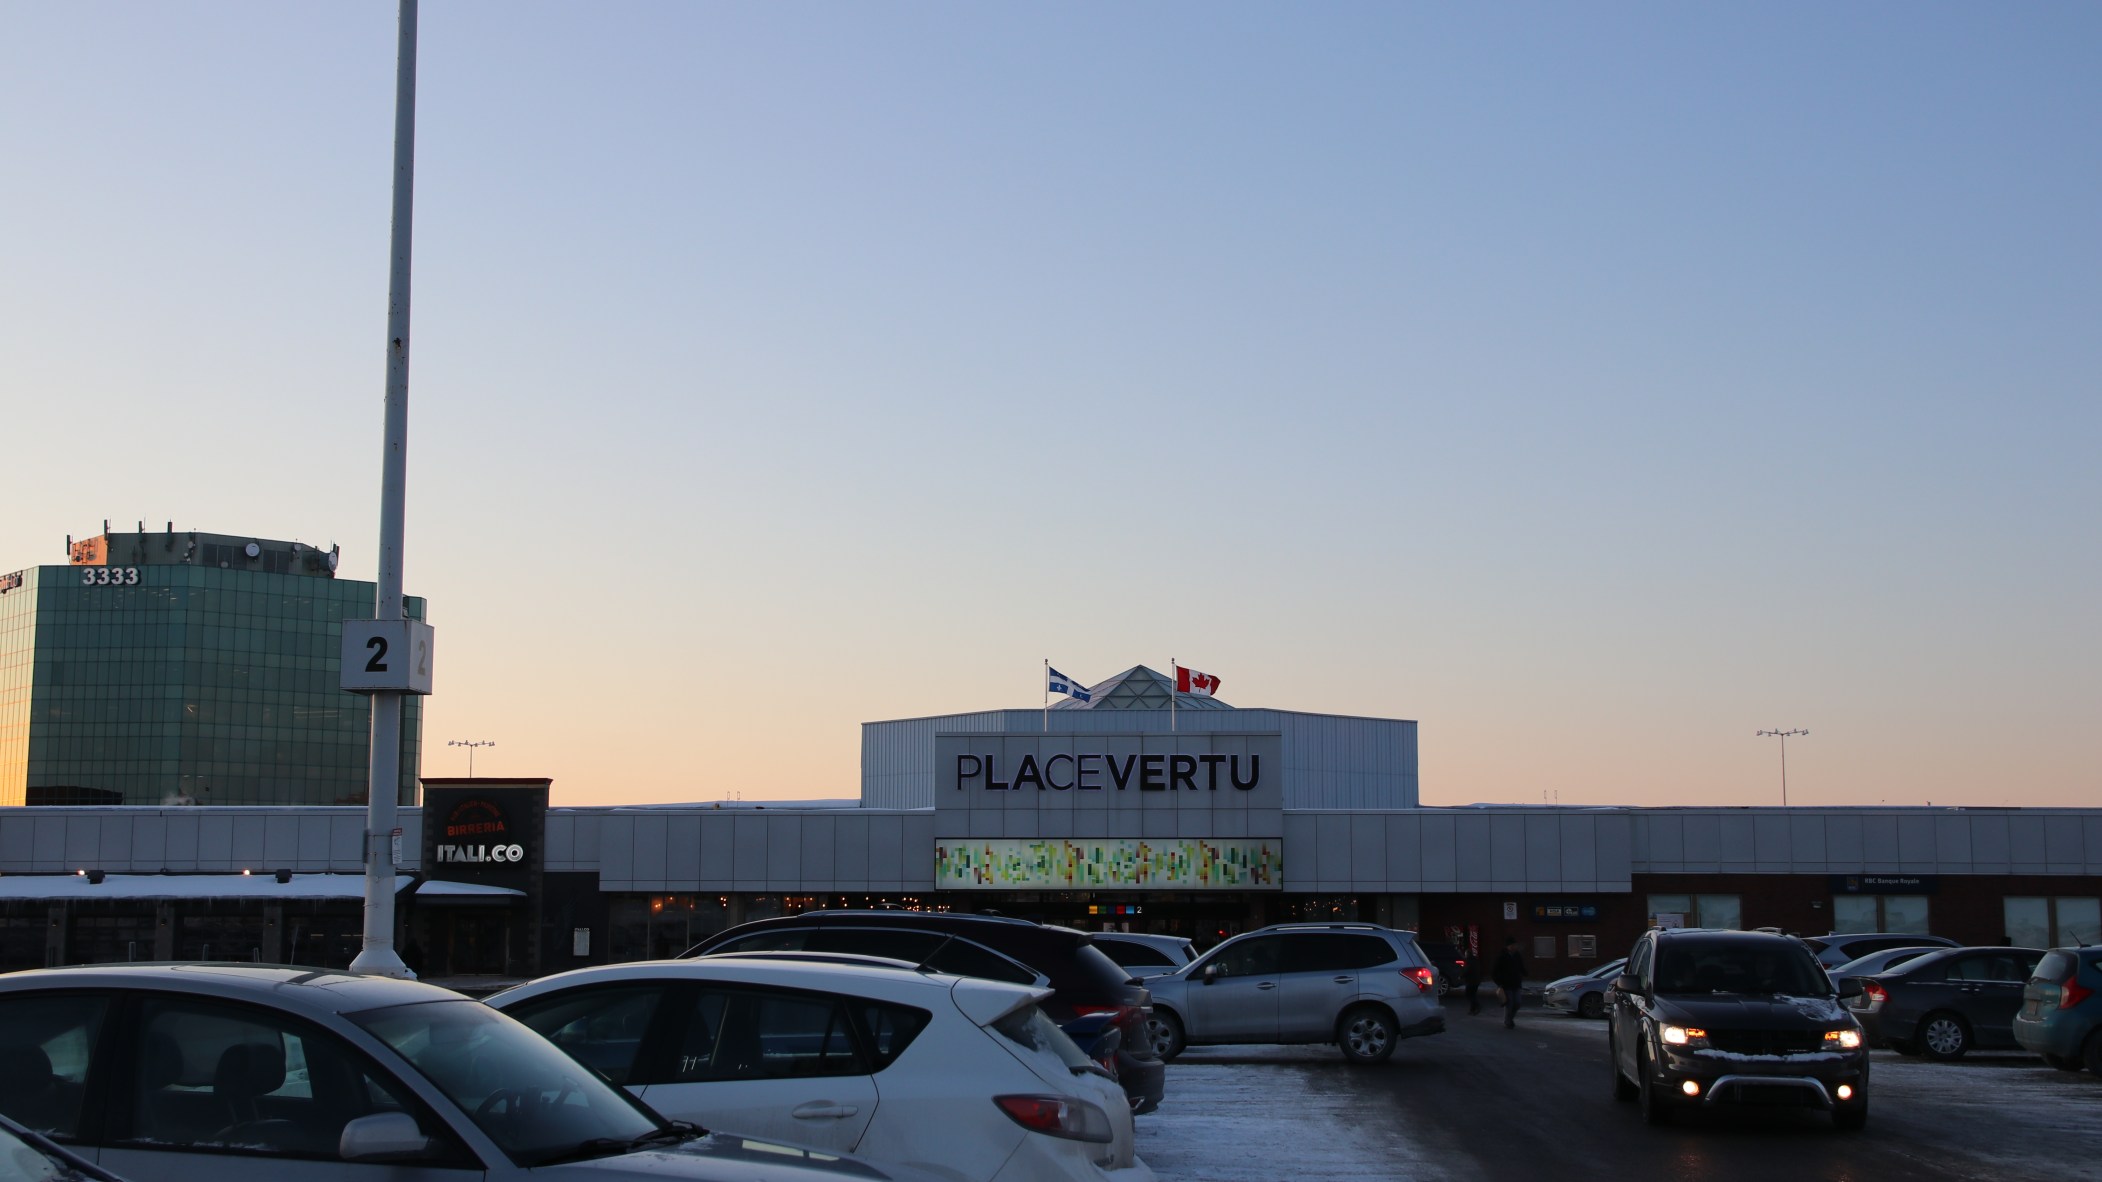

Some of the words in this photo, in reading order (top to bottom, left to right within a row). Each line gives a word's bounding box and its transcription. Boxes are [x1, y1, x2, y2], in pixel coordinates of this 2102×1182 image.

[82, 567, 141, 586] 3333
[365, 636, 389, 673] 2
[417, 640, 427, 676] 2
[447, 820, 505, 837] BIRRERIA
[436, 843, 524, 862] ITALI.CO
[1877, 877, 1899, 887] Banque
[1136, 906, 1142, 914] 2
